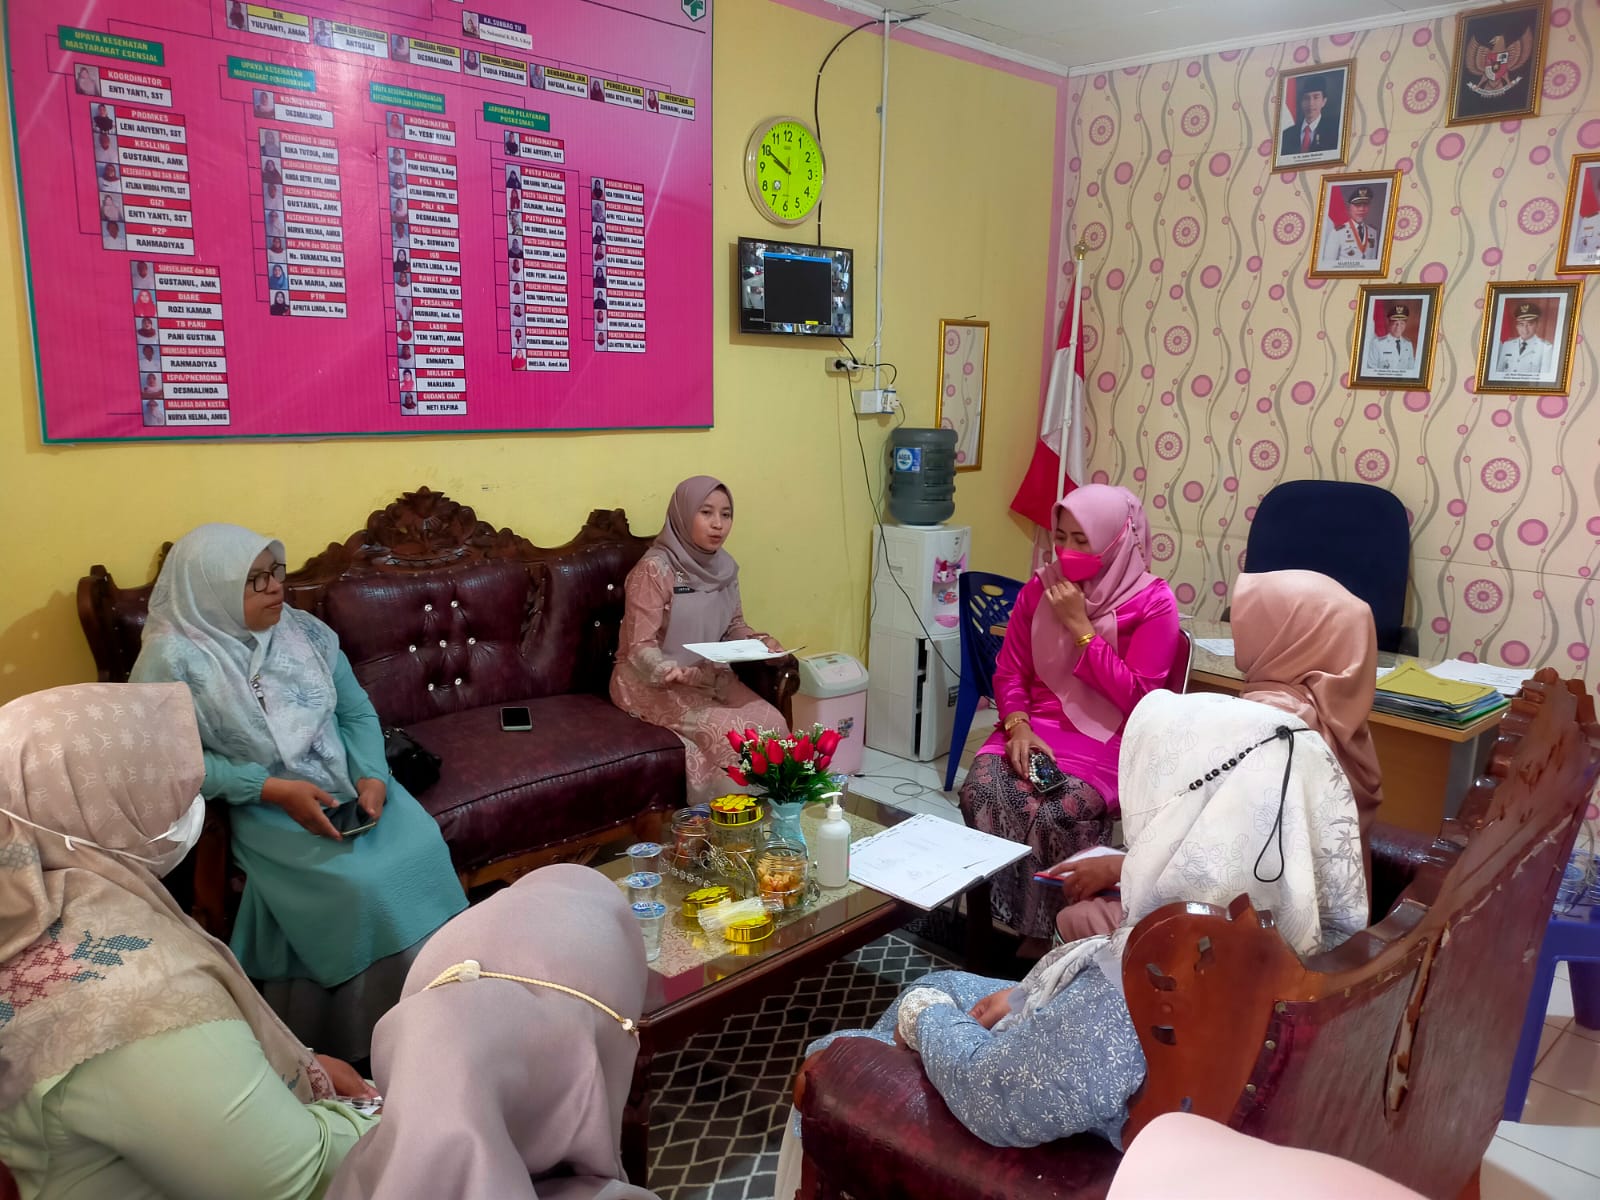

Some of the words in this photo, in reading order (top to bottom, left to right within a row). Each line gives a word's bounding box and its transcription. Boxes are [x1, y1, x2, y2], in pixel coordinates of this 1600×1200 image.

[74, 31, 100, 42] UPAYA
[103, 36, 147, 50] KESEHATAN
[65, 40, 119, 55] MASYARAKAT
[122, 50, 158, 62] ESENSIAL
[240, 61, 263, 71] UPAYA
[264, 65, 302, 78] KESEHATAN
[547, 68, 574, 79] BENDAHARA
[107, 71, 162, 86] KOORDINATOR
[108, 85, 124, 94] ENTI
[126, 88, 149, 98] YANTI,
[151, 92, 164, 100] SST
[131, 110, 168, 122] PROMKES
[488, 105, 514, 115] JARINGAN
[515, 110, 545, 120] PELAYANAN
[409, 117, 448, 128] KOORDINATOR
[500, 115, 534, 127] PUSKESMAS
[119, 122, 134, 131] LENI
[169, 129, 182, 138] SST
[773, 133, 779, 144] 11
[784, 131, 792, 142] 12
[799, 137, 802, 148] 1
[762, 144, 771, 156] 10
[122, 152, 164, 164] GUSTANUL,
[166, 157, 183, 166] AMK
[414, 152, 427, 160] POLI
[805, 152, 810, 162] 2
[760, 162, 765, 173] 9
[808, 169, 812, 180] 3
[762, 180, 767, 191] 8
[804, 187, 810, 197] 4
[150, 198, 164, 206] GIZI
[287, 199, 321, 209] GUSTANUL,
[323, 203, 337, 211] AMK
[772, 194, 777, 205] 7
[795, 197, 800, 208] 5
[783, 201, 788, 211] 6
[128, 210, 145, 218] ENTI
[146, 212, 172, 221] YANTI,
[173, 214, 187, 222] SST
[415, 213, 451, 222] DESMALINDA
[136, 239, 184, 249] RAHMADIYAS
[158, 278, 198, 287] GUSTANUL,
[199, 280, 216, 288] AMK
